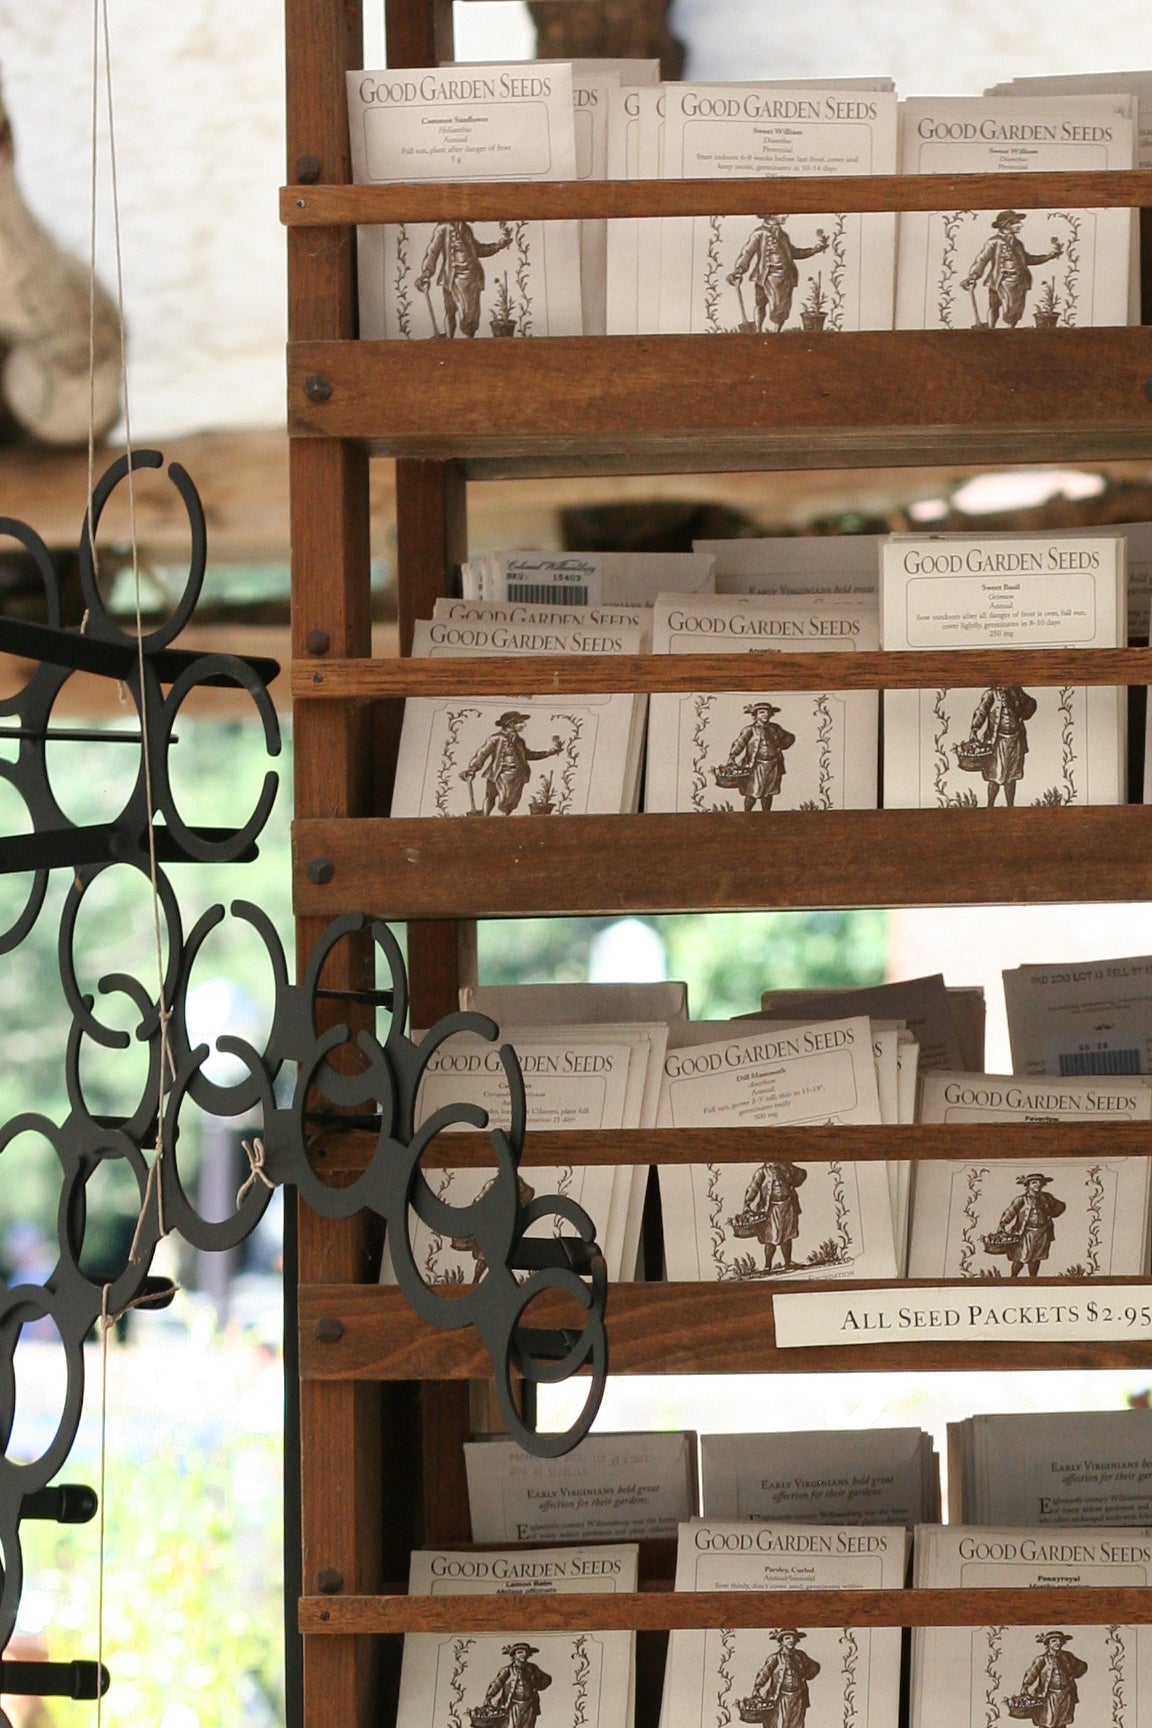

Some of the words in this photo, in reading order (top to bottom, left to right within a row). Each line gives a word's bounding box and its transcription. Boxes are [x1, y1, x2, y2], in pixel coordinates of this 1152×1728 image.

[360, 77, 416, 104] GOOD
[420, 76, 495, 100] GARDEN
[500, 73, 551, 98] SEEDS
[681, 93, 740, 117] GOOD
[743, 94, 820, 119] GARDEN
[825, 96, 877, 120] SEEDS
[918, 118, 976, 140] GOOD
[980, 120, 1056, 140] GARDEN
[1060, 122, 1112, 142] SEEDS
[904, 551, 962, 574] GOOD
[966, 549, 1042, 572] GARDEN
[1048, 547, 1100, 570] SEEDS
[668, 611, 726, 633] GOOD
[729, 615, 804, 635] GARDEN
[808, 616, 860, 636] SEEDS
[430, 624, 488, 646] GOOD
[491, 628, 568, 650] GARDEN
[570, 632, 622, 652] SEEDS
[563, 1051, 613, 1072] SEEDS
[664, 1055, 722, 1078] GOOD
[725, 1038, 800, 1068] GARDEN
[804, 1028, 854, 1052] SEEDS
[944, 1084, 1002, 1107] GOOD
[1006, 1089, 1082, 1110] GARDEN
[1087, 1092, 1136, 1111] SEEDS
[840, 1310, 892, 1332] ALL
[898, 1307, 960, 1329] SEED
[968, 1305, 1080, 1328] PACKETS
[1086, 1301, 1152, 1328] $2.95
[695, 1528, 752, 1550] GOOD
[756, 1530, 832, 1552] GARDEN
[837, 1532, 888, 1552] SEEDS
[959, 1538, 1017, 1560] GOOD
[1020, 1539, 1096, 1562] GARDEN
[1100, 1542, 1151, 1562] SEEDS
[431, 1556, 488, 1577] GOOD
[492, 1559, 566, 1579] GARDEN
[572, 1558, 622, 1575] SEEDS
